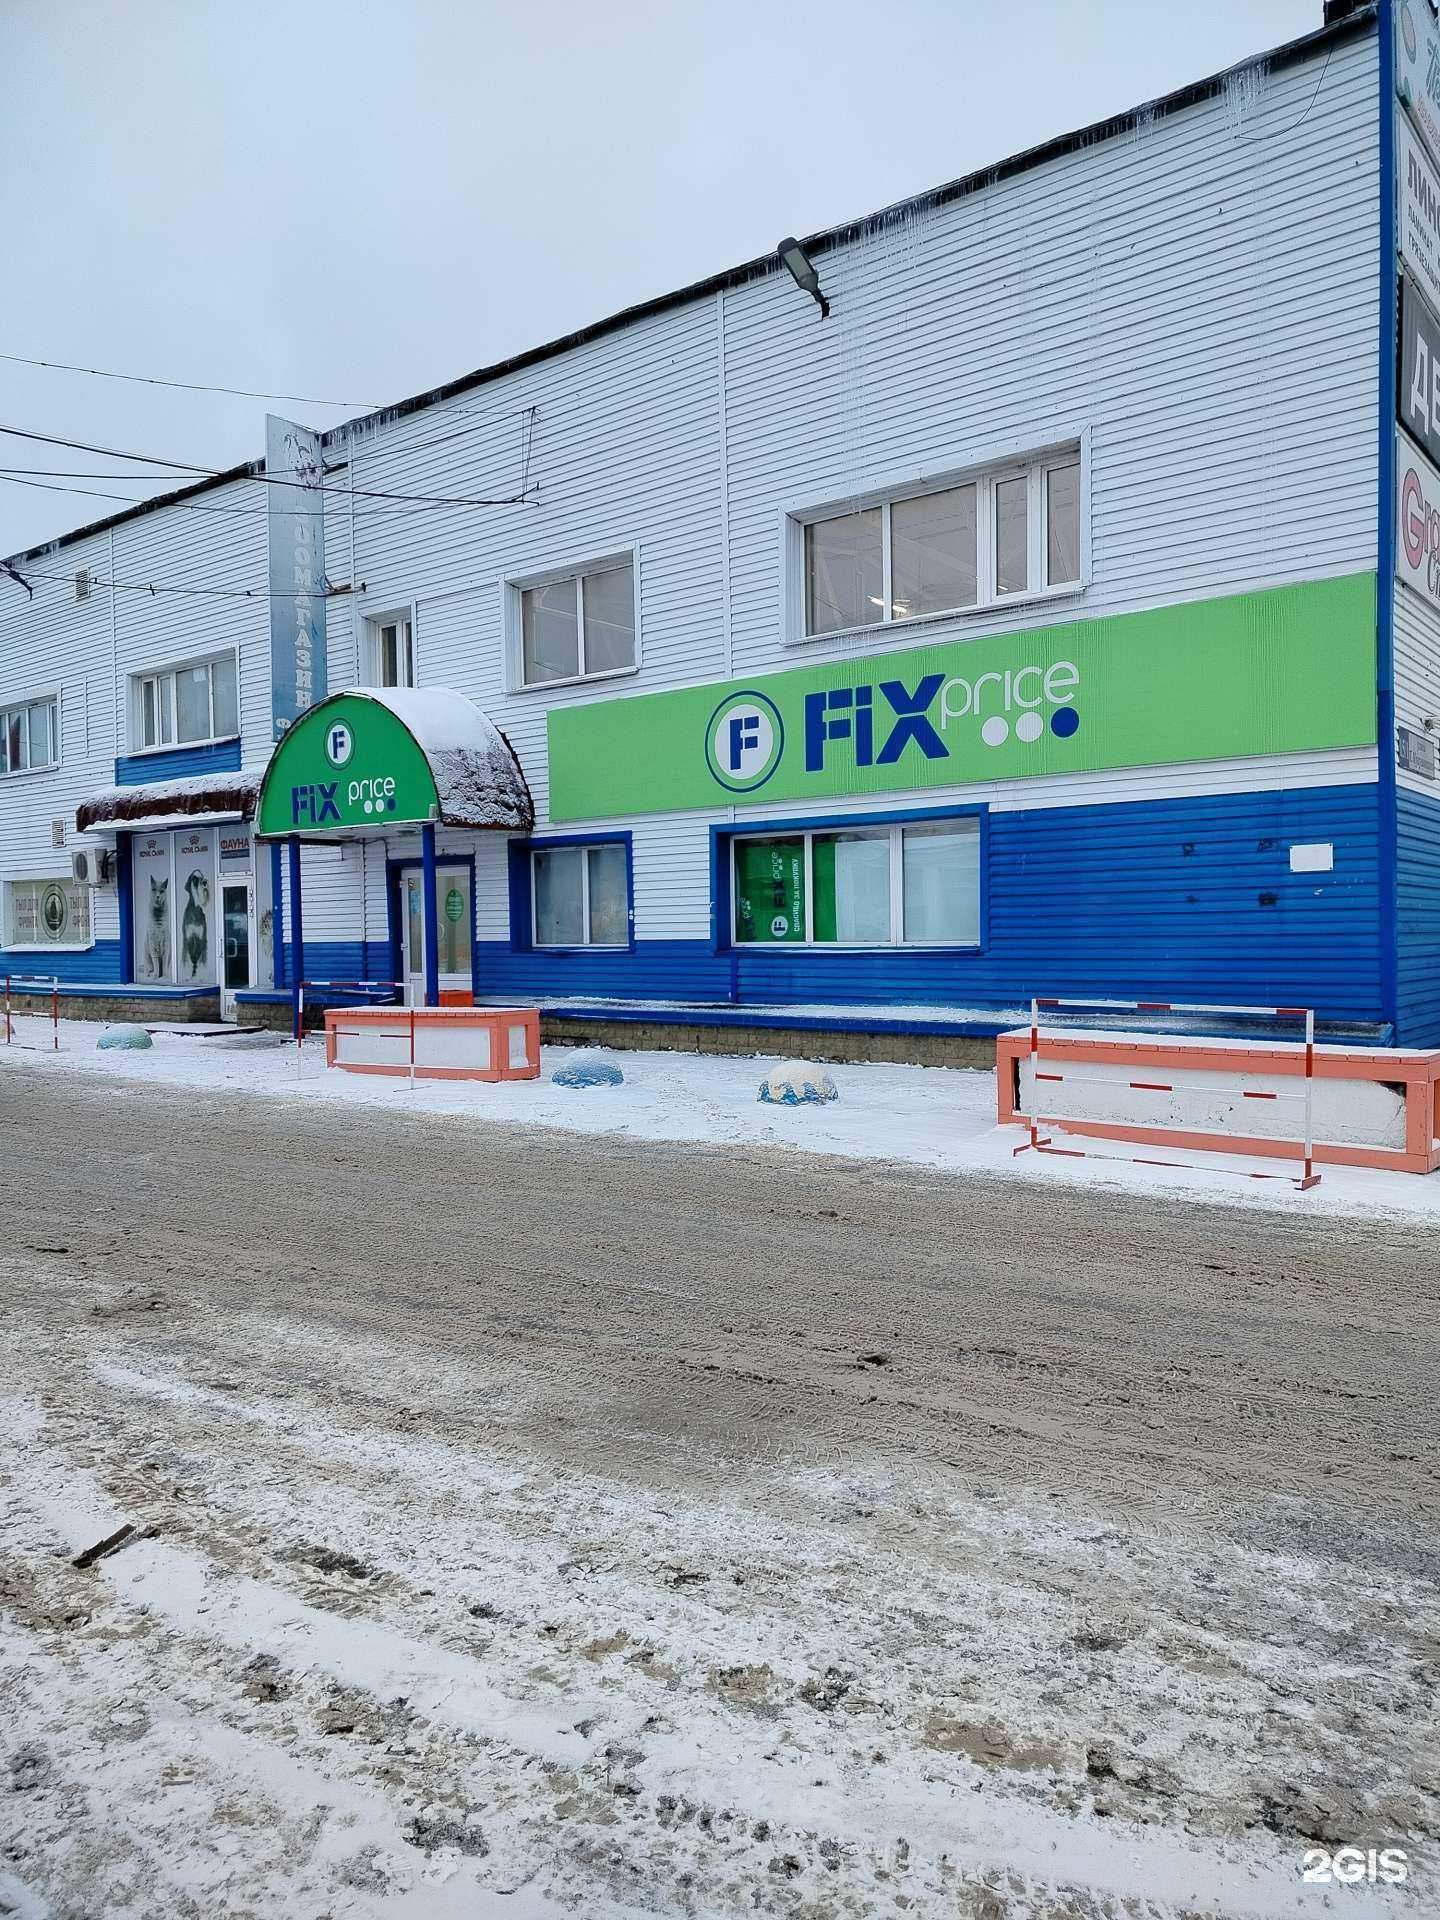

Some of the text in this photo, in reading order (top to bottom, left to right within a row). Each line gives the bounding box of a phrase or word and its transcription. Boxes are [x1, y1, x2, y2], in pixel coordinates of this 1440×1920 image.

[940, 661, 1080, 730] price
[332, 731, 346, 759] F
[729, 716, 759, 770] F
[348, 776, 396, 807] price
[221, 837, 250, 849] ФАУНА
